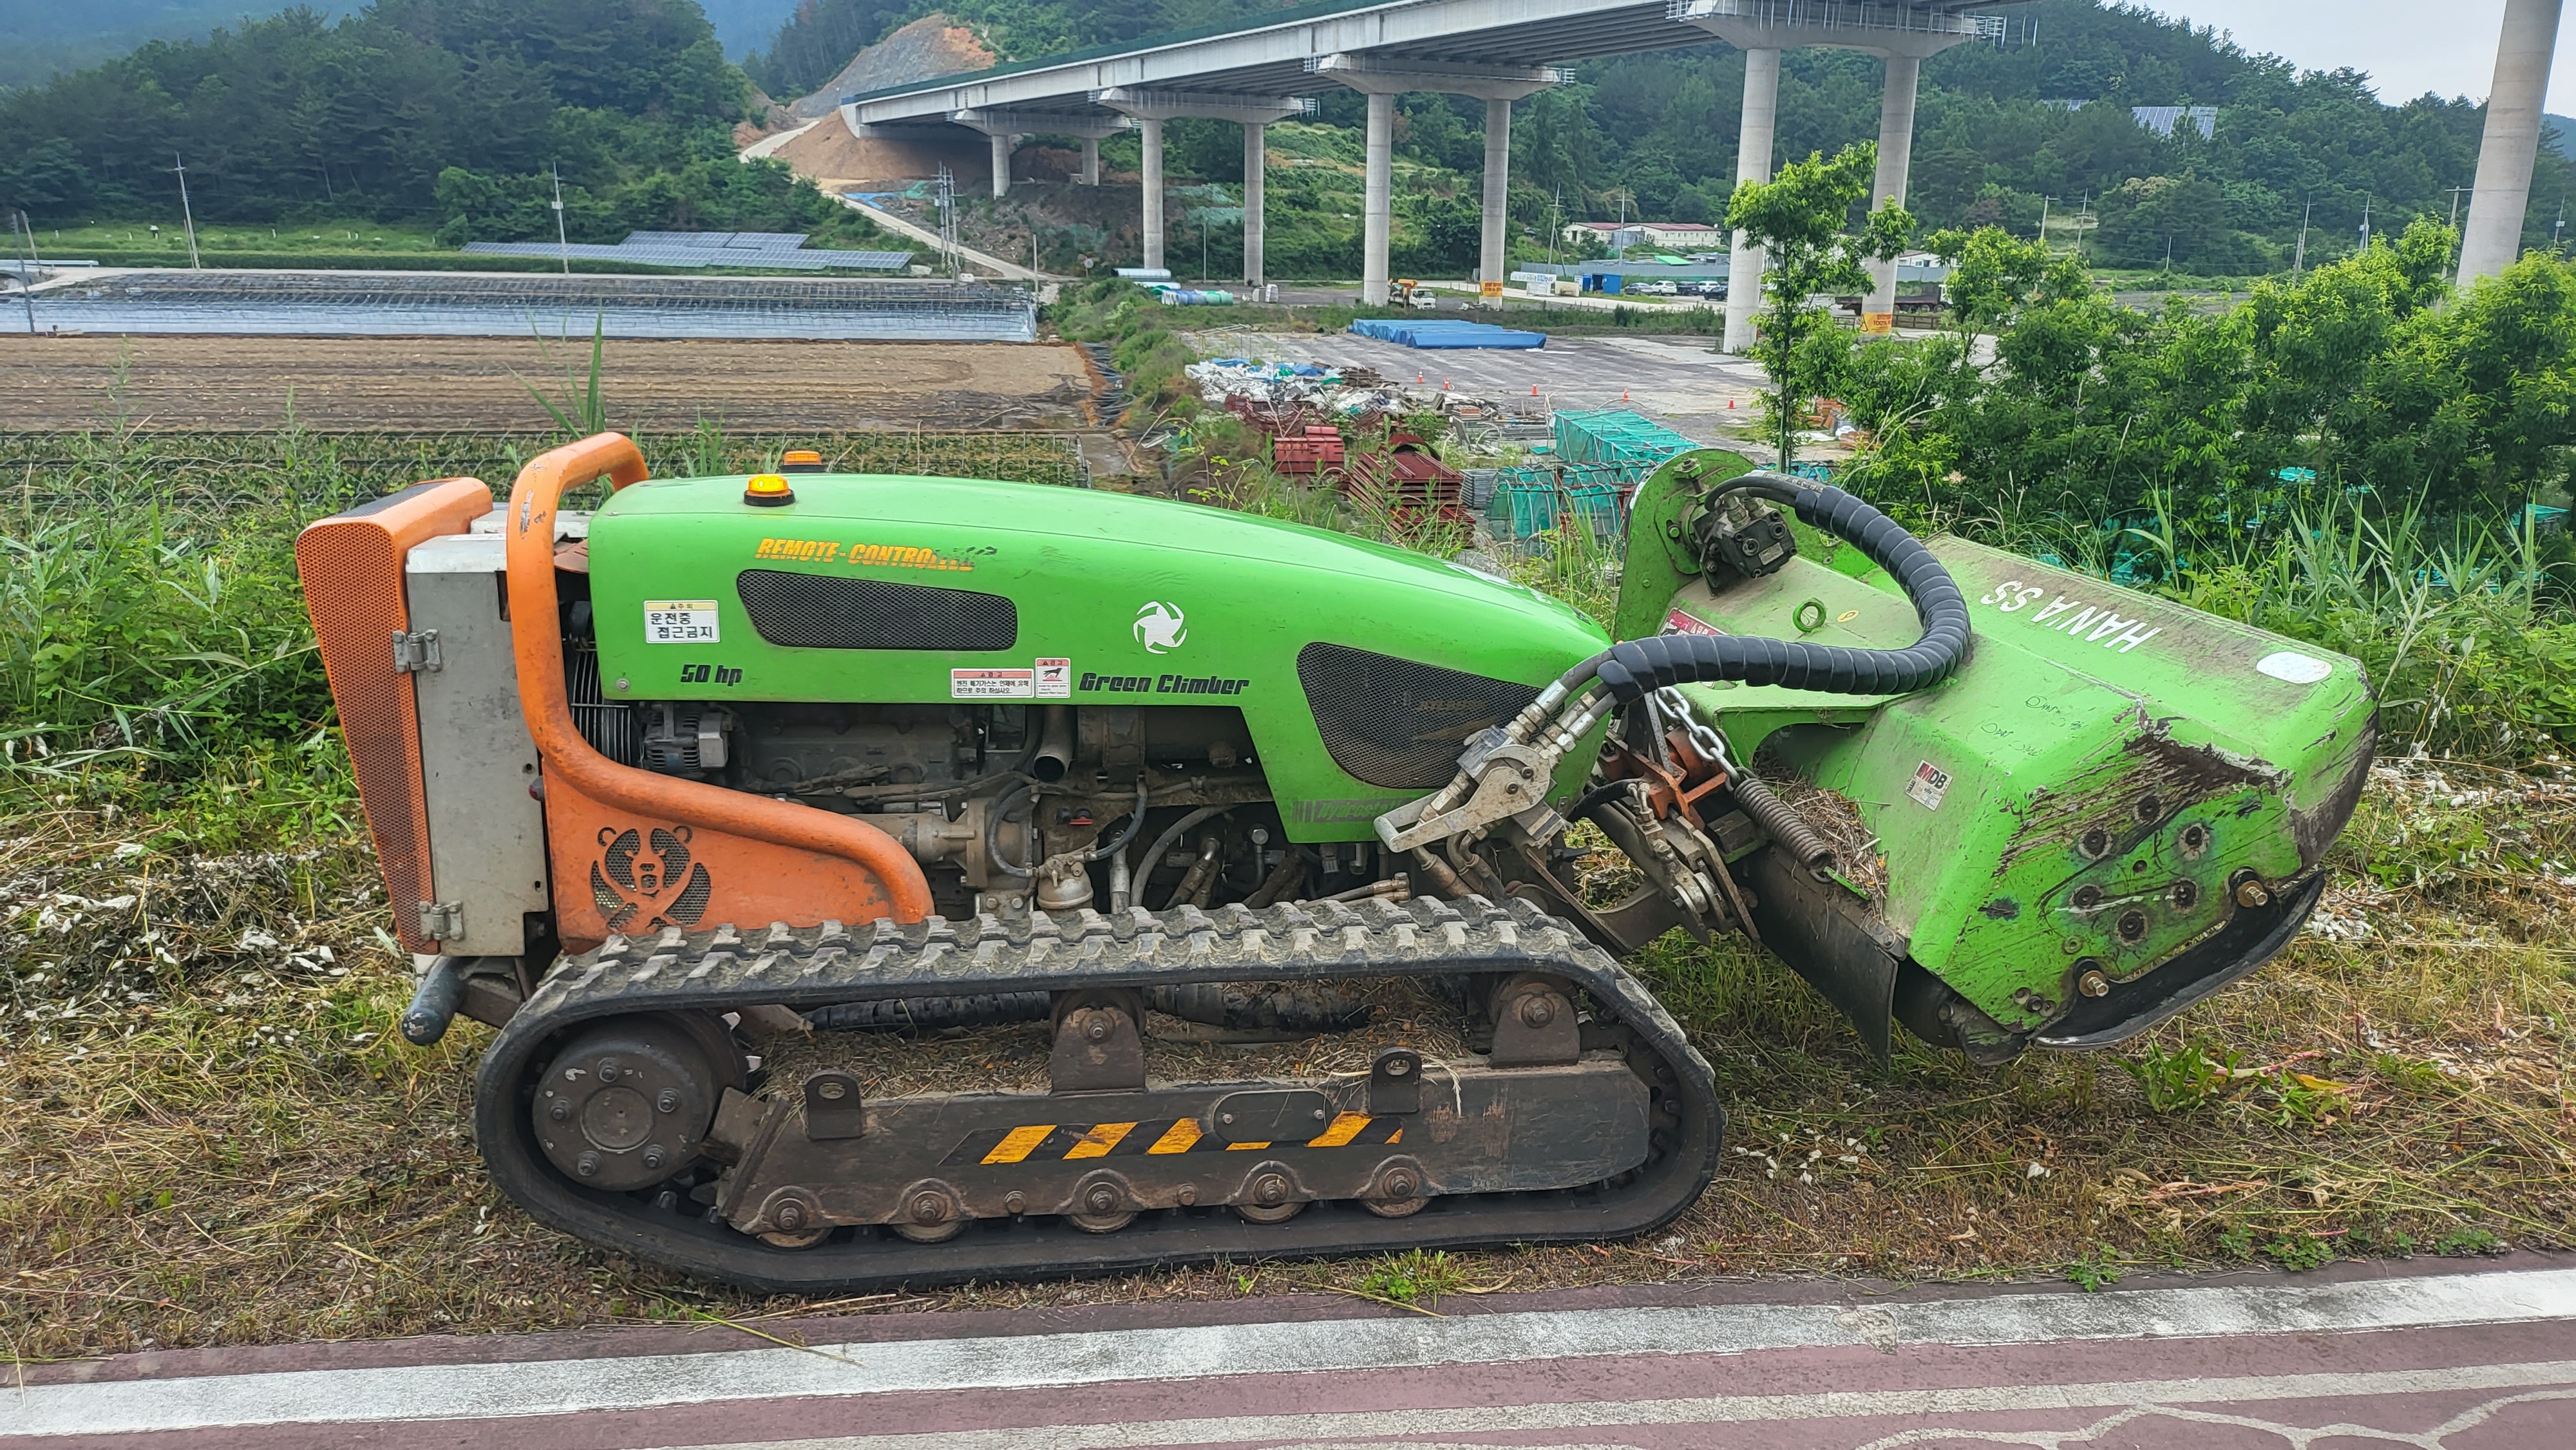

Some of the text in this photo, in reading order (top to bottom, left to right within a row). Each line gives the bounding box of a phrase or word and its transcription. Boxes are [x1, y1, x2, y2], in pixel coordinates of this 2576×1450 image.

[1980, 581, 2043, 612] SS
[650, 612, 691, 625] 운전중
[658, 626, 713, 638] 접근금지
[680, 664, 743, 687] 50 hp
[1079, 672, 1250, 695] Green Climber
